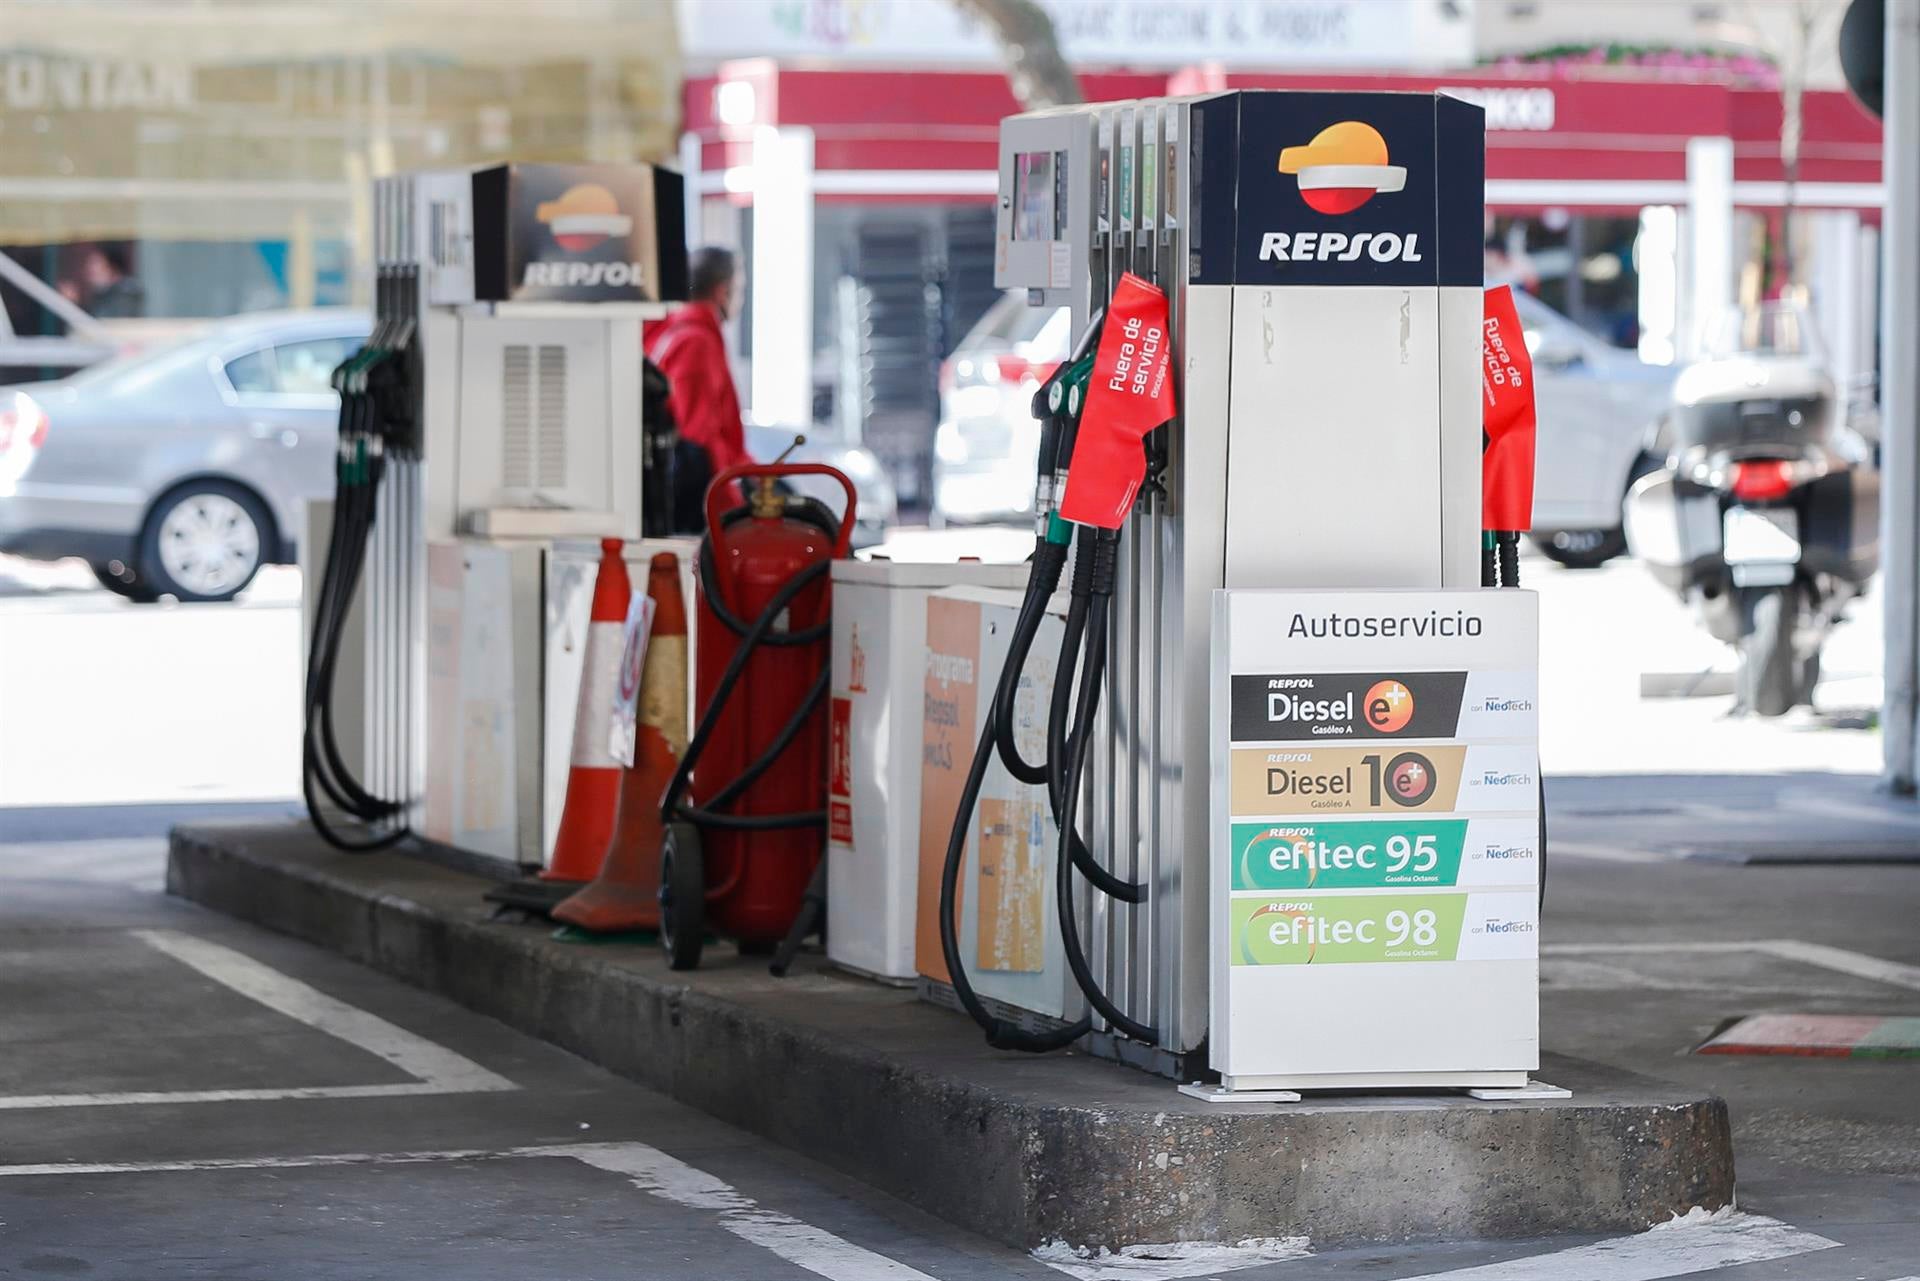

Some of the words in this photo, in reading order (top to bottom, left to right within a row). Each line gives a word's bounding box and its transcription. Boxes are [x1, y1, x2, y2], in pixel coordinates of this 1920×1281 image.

[1259, 232, 1422, 263] REPSOL
[523, 261, 644, 287] REPSOL
[1110, 342, 1135, 391] Fuera
[1123, 317, 1142, 340] de
[1132, 327, 1161, 395] servicio
[1484, 316, 1510, 364] Fuera
[1507, 365, 1522, 388] de
[1288, 610, 1482, 638] Autoservicio
[1268, 679, 1315, 689] REPSOL
[1268, 691, 1353, 721] Diesel
[1485, 699, 1532, 711] NeoTech
[1345, 725, 1353, 734] A
[1266, 753, 1313, 763] REPSOL
[1267, 767, 1352, 796] Diesel
[1484, 773, 1531, 785] NeoTech
[1344, 800, 1352, 808] A
[1269, 827, 1315, 837] REPSOL
[1269, 841, 1377, 871] efitec
[1385, 834, 1438, 873] 95
[1486, 847, 1533, 859] NeoTech
[1268, 902, 1314, 912] REPSOL
[1268, 916, 1376, 945] efitec
[1385, 909, 1438, 948] 98
[1486, 921, 1533, 933] NeoTech
